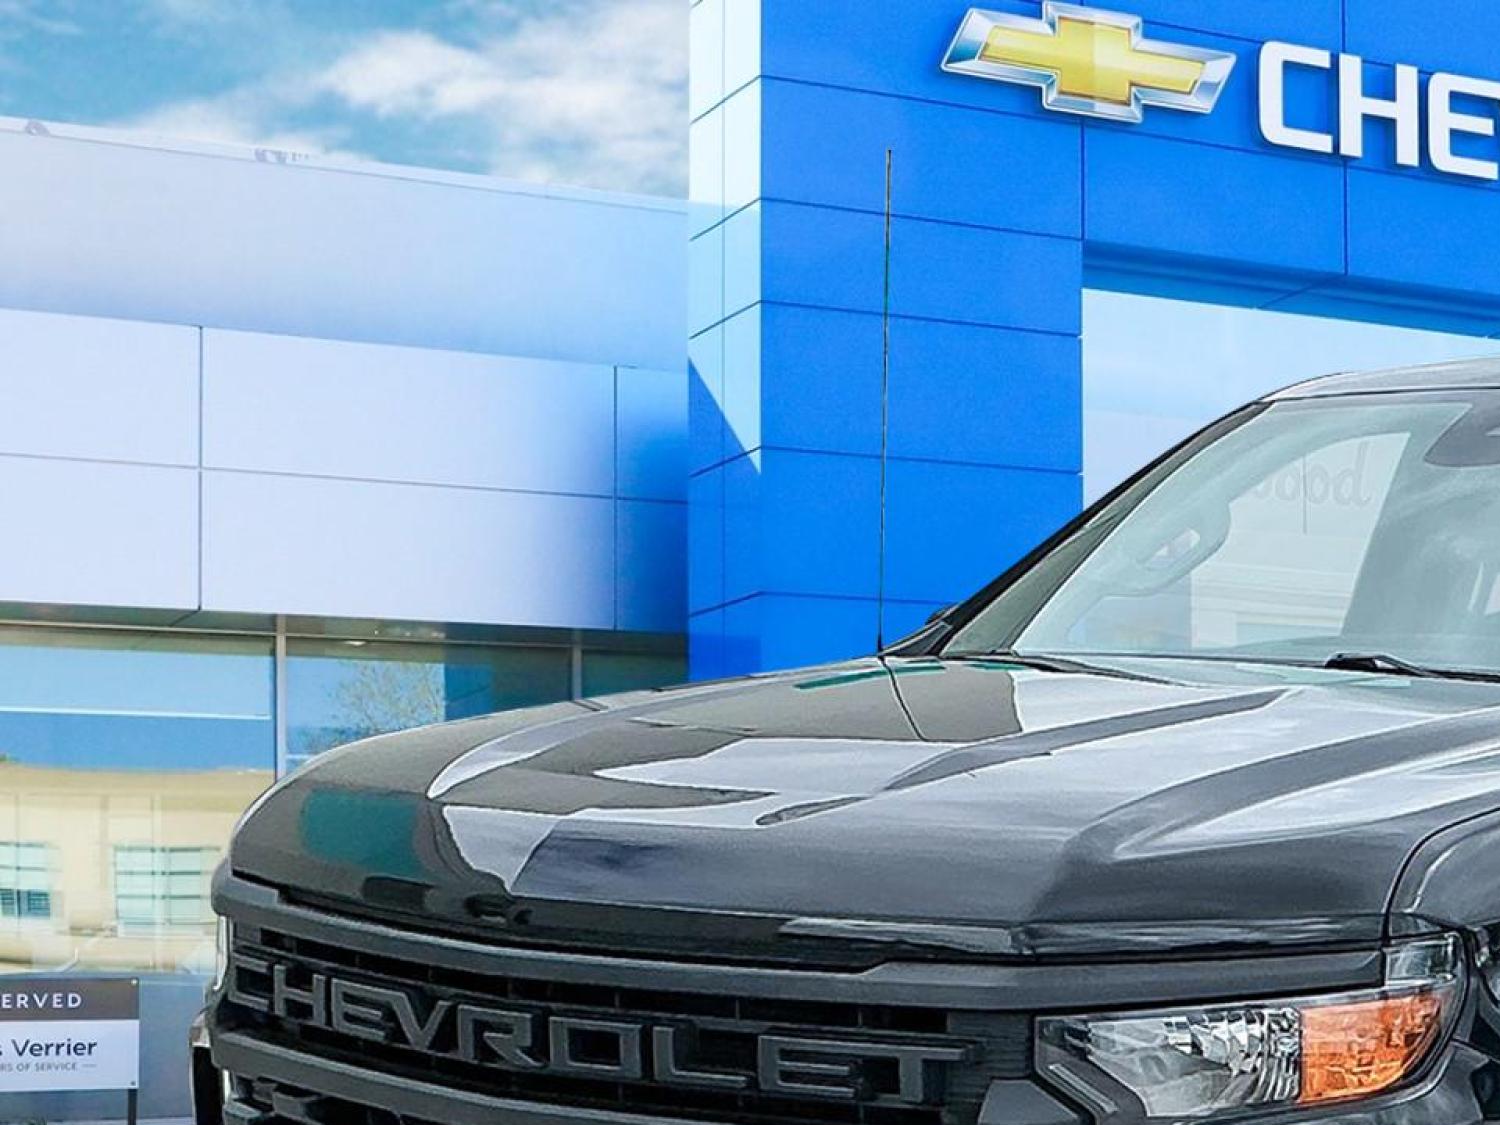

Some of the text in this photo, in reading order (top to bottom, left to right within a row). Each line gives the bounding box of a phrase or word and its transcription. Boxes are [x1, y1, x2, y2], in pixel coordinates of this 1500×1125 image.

[227, 948, 980, 1104] CHEVROLET
[11, 1038, 98, 1057] Verrier
[16, 1063, 31, 1072] OF
[35, 1062, 77, 1072] SERVICE
